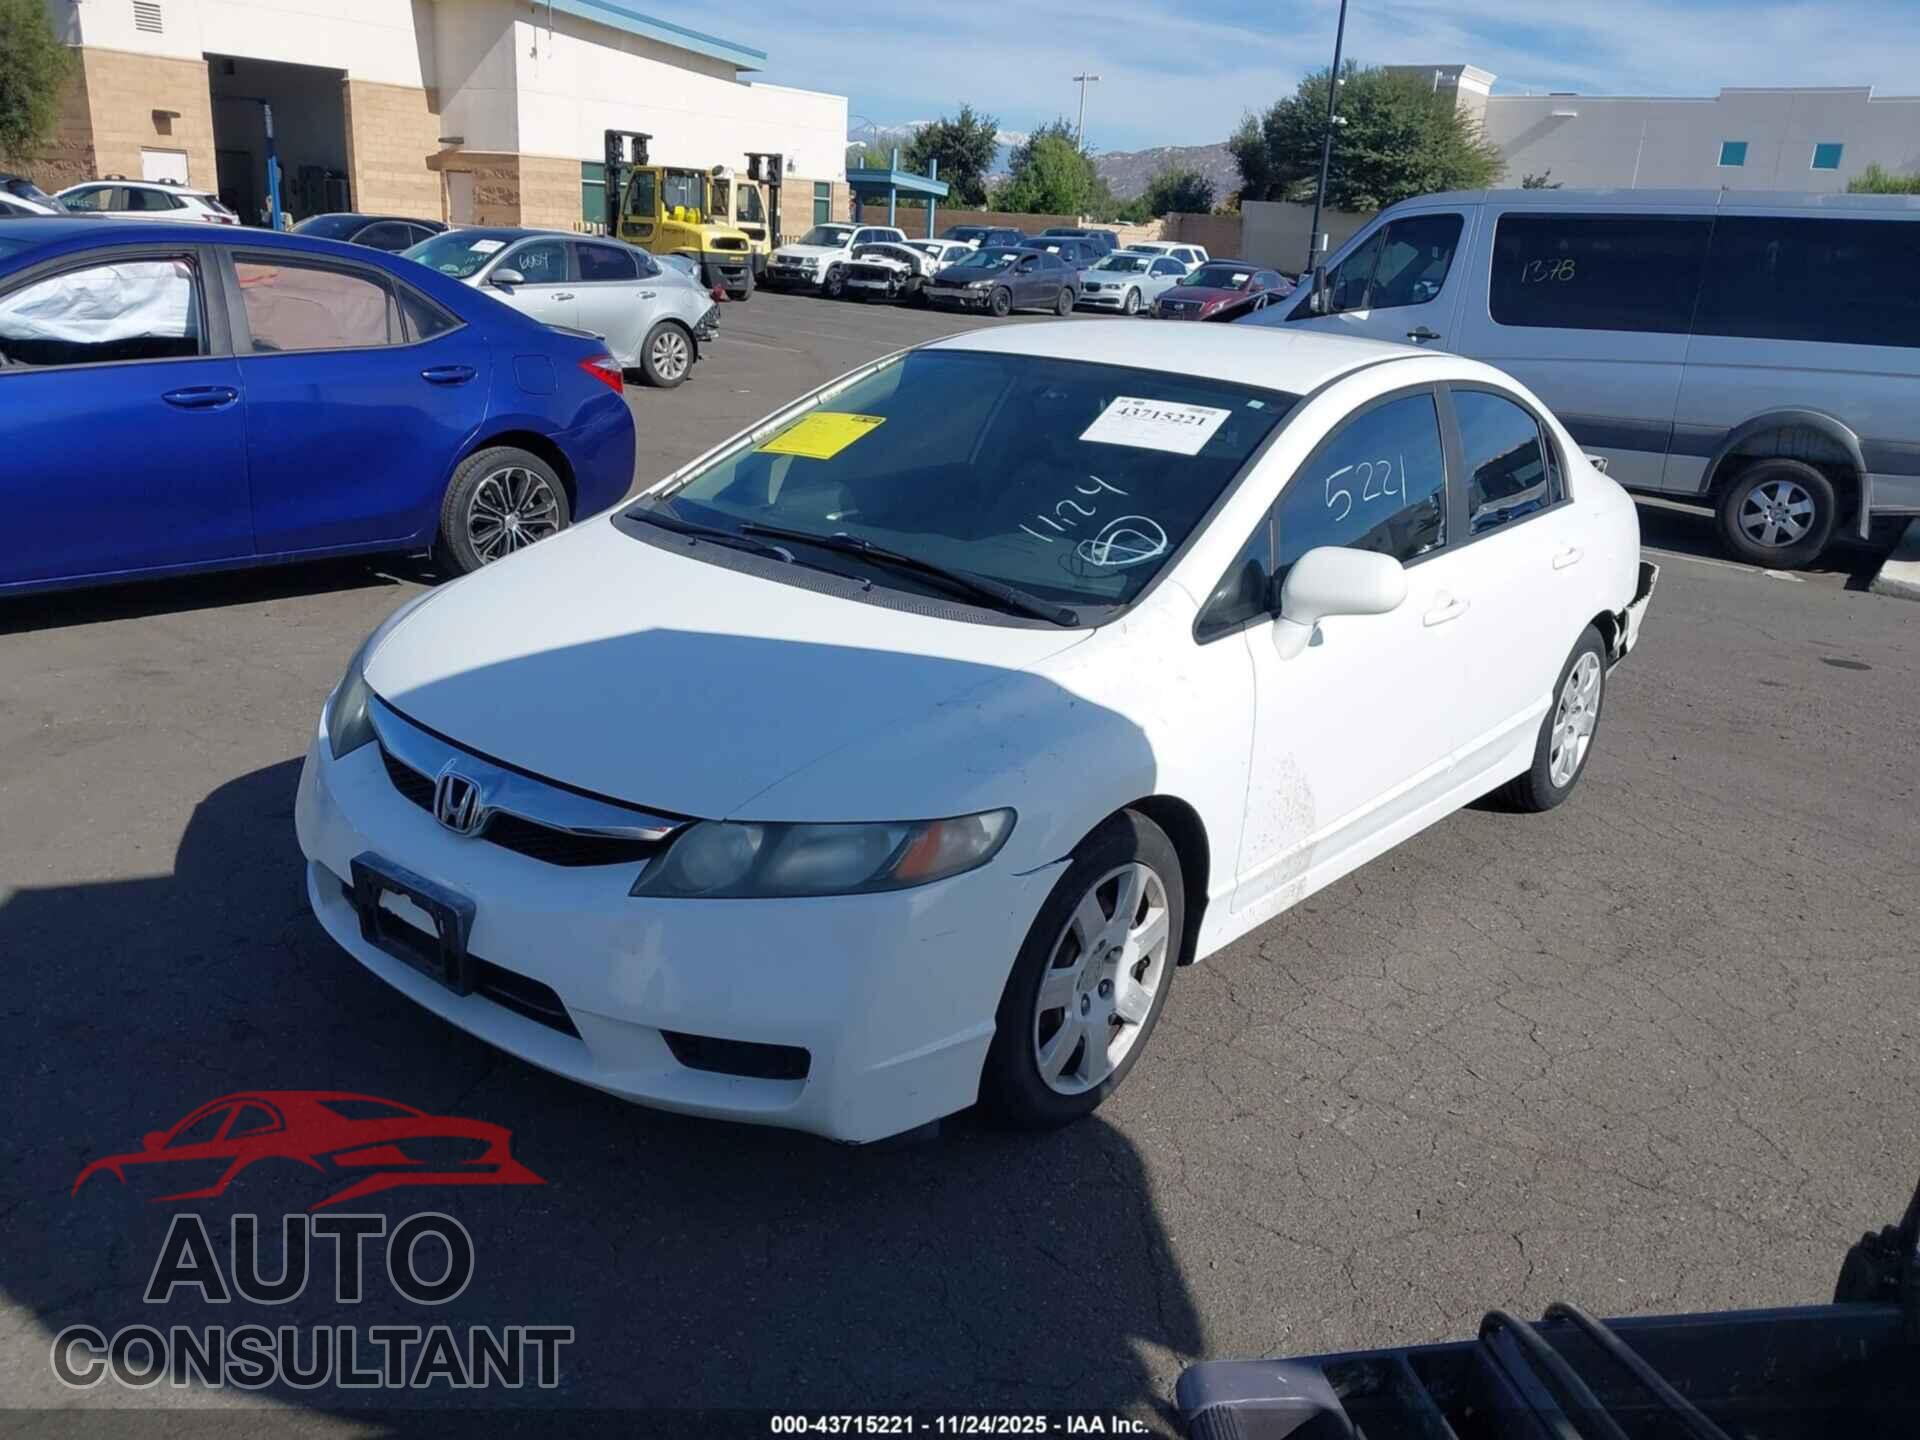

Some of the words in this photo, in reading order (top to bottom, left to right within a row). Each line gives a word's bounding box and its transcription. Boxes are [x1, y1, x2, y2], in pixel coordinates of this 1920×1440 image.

[1520, 258, 1576, 283] 1378
[1116, 406, 1207, 426] 43715221
[1324, 452, 1408, 523] 5221
